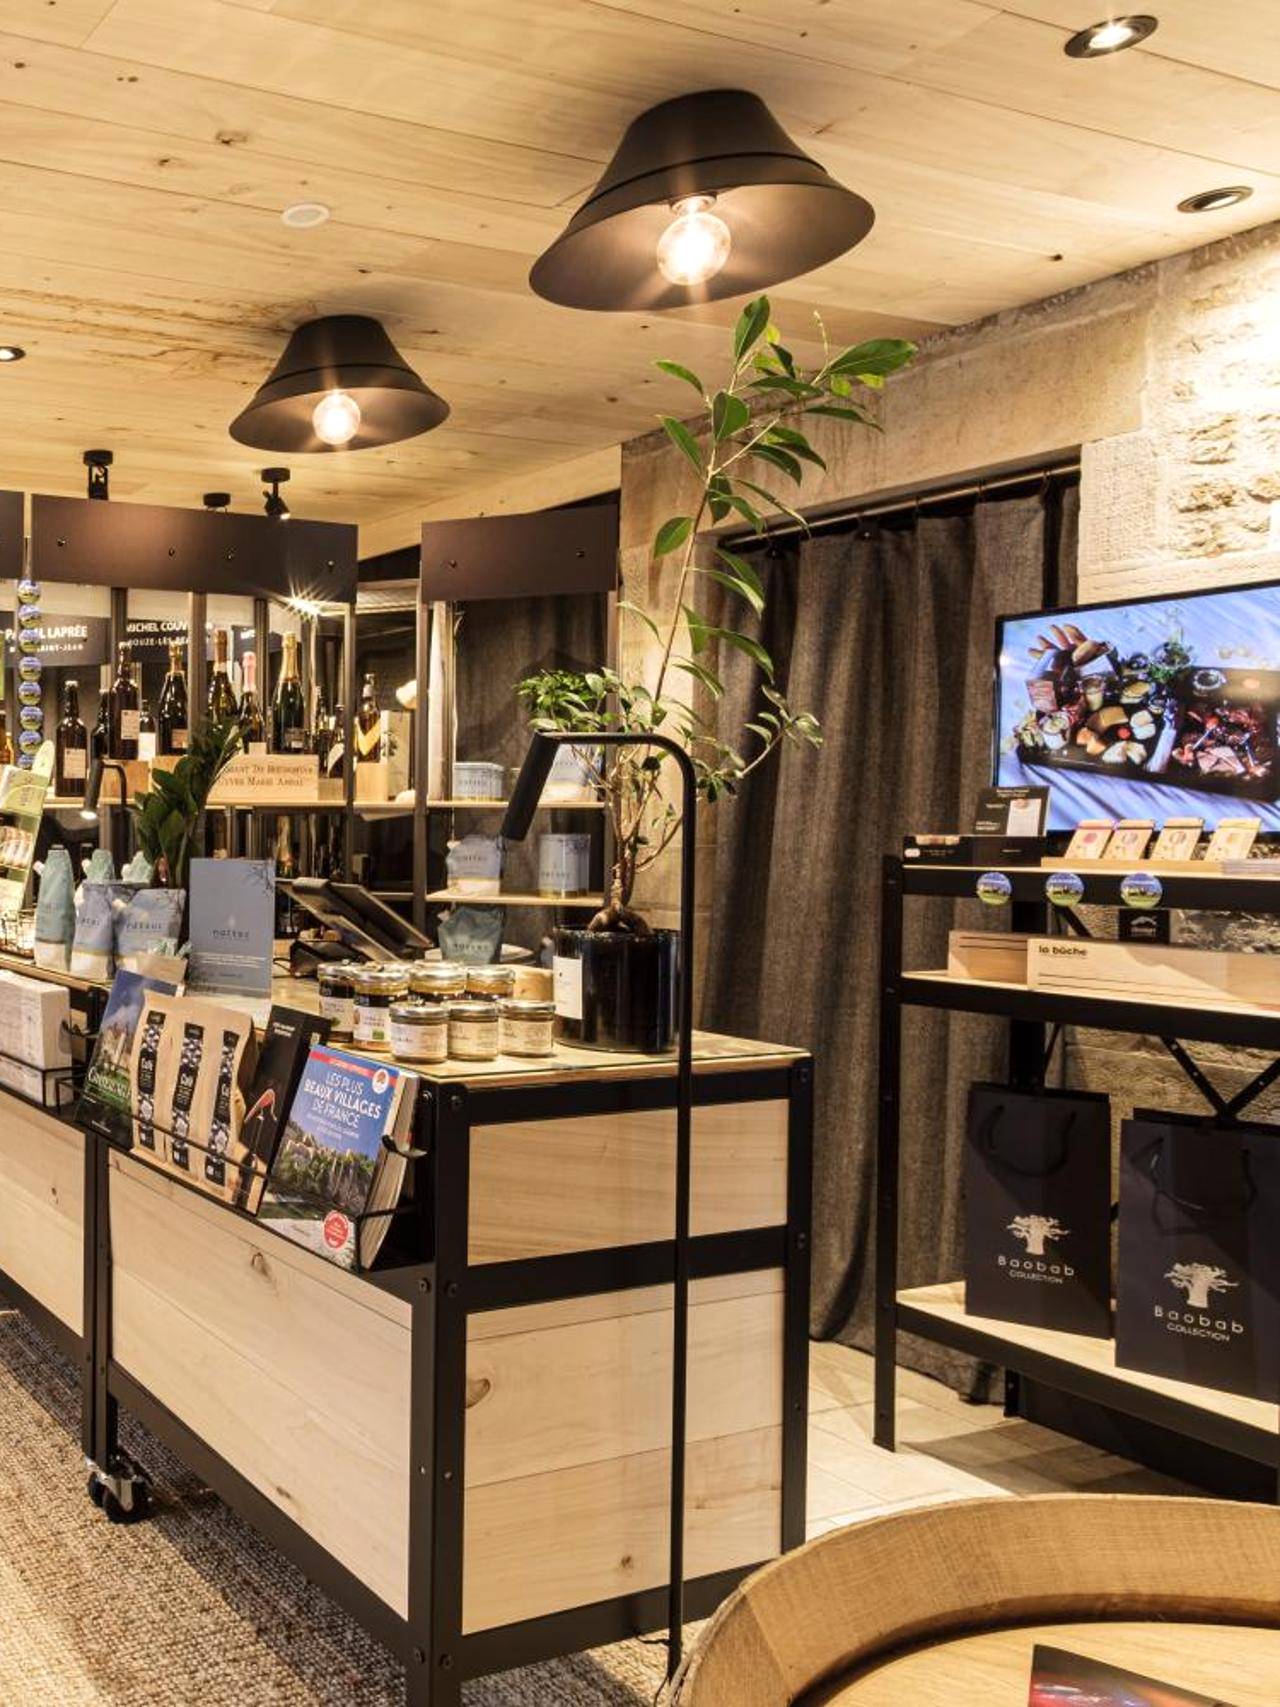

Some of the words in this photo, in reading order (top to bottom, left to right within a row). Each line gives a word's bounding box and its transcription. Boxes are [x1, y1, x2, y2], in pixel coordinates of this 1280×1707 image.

[47, 624, 88, 638] LAPRÉE
[341, 1076, 364, 1095] PLUS
[304, 1078, 333, 1100] BEAUX
[334, 1091, 381, 1119] VILLAGES
[324, 1103, 360, 1128] FRANCE
[998, 1255, 1075, 1276] Baobab
[1154, 1305, 1244, 1334] Baobab
